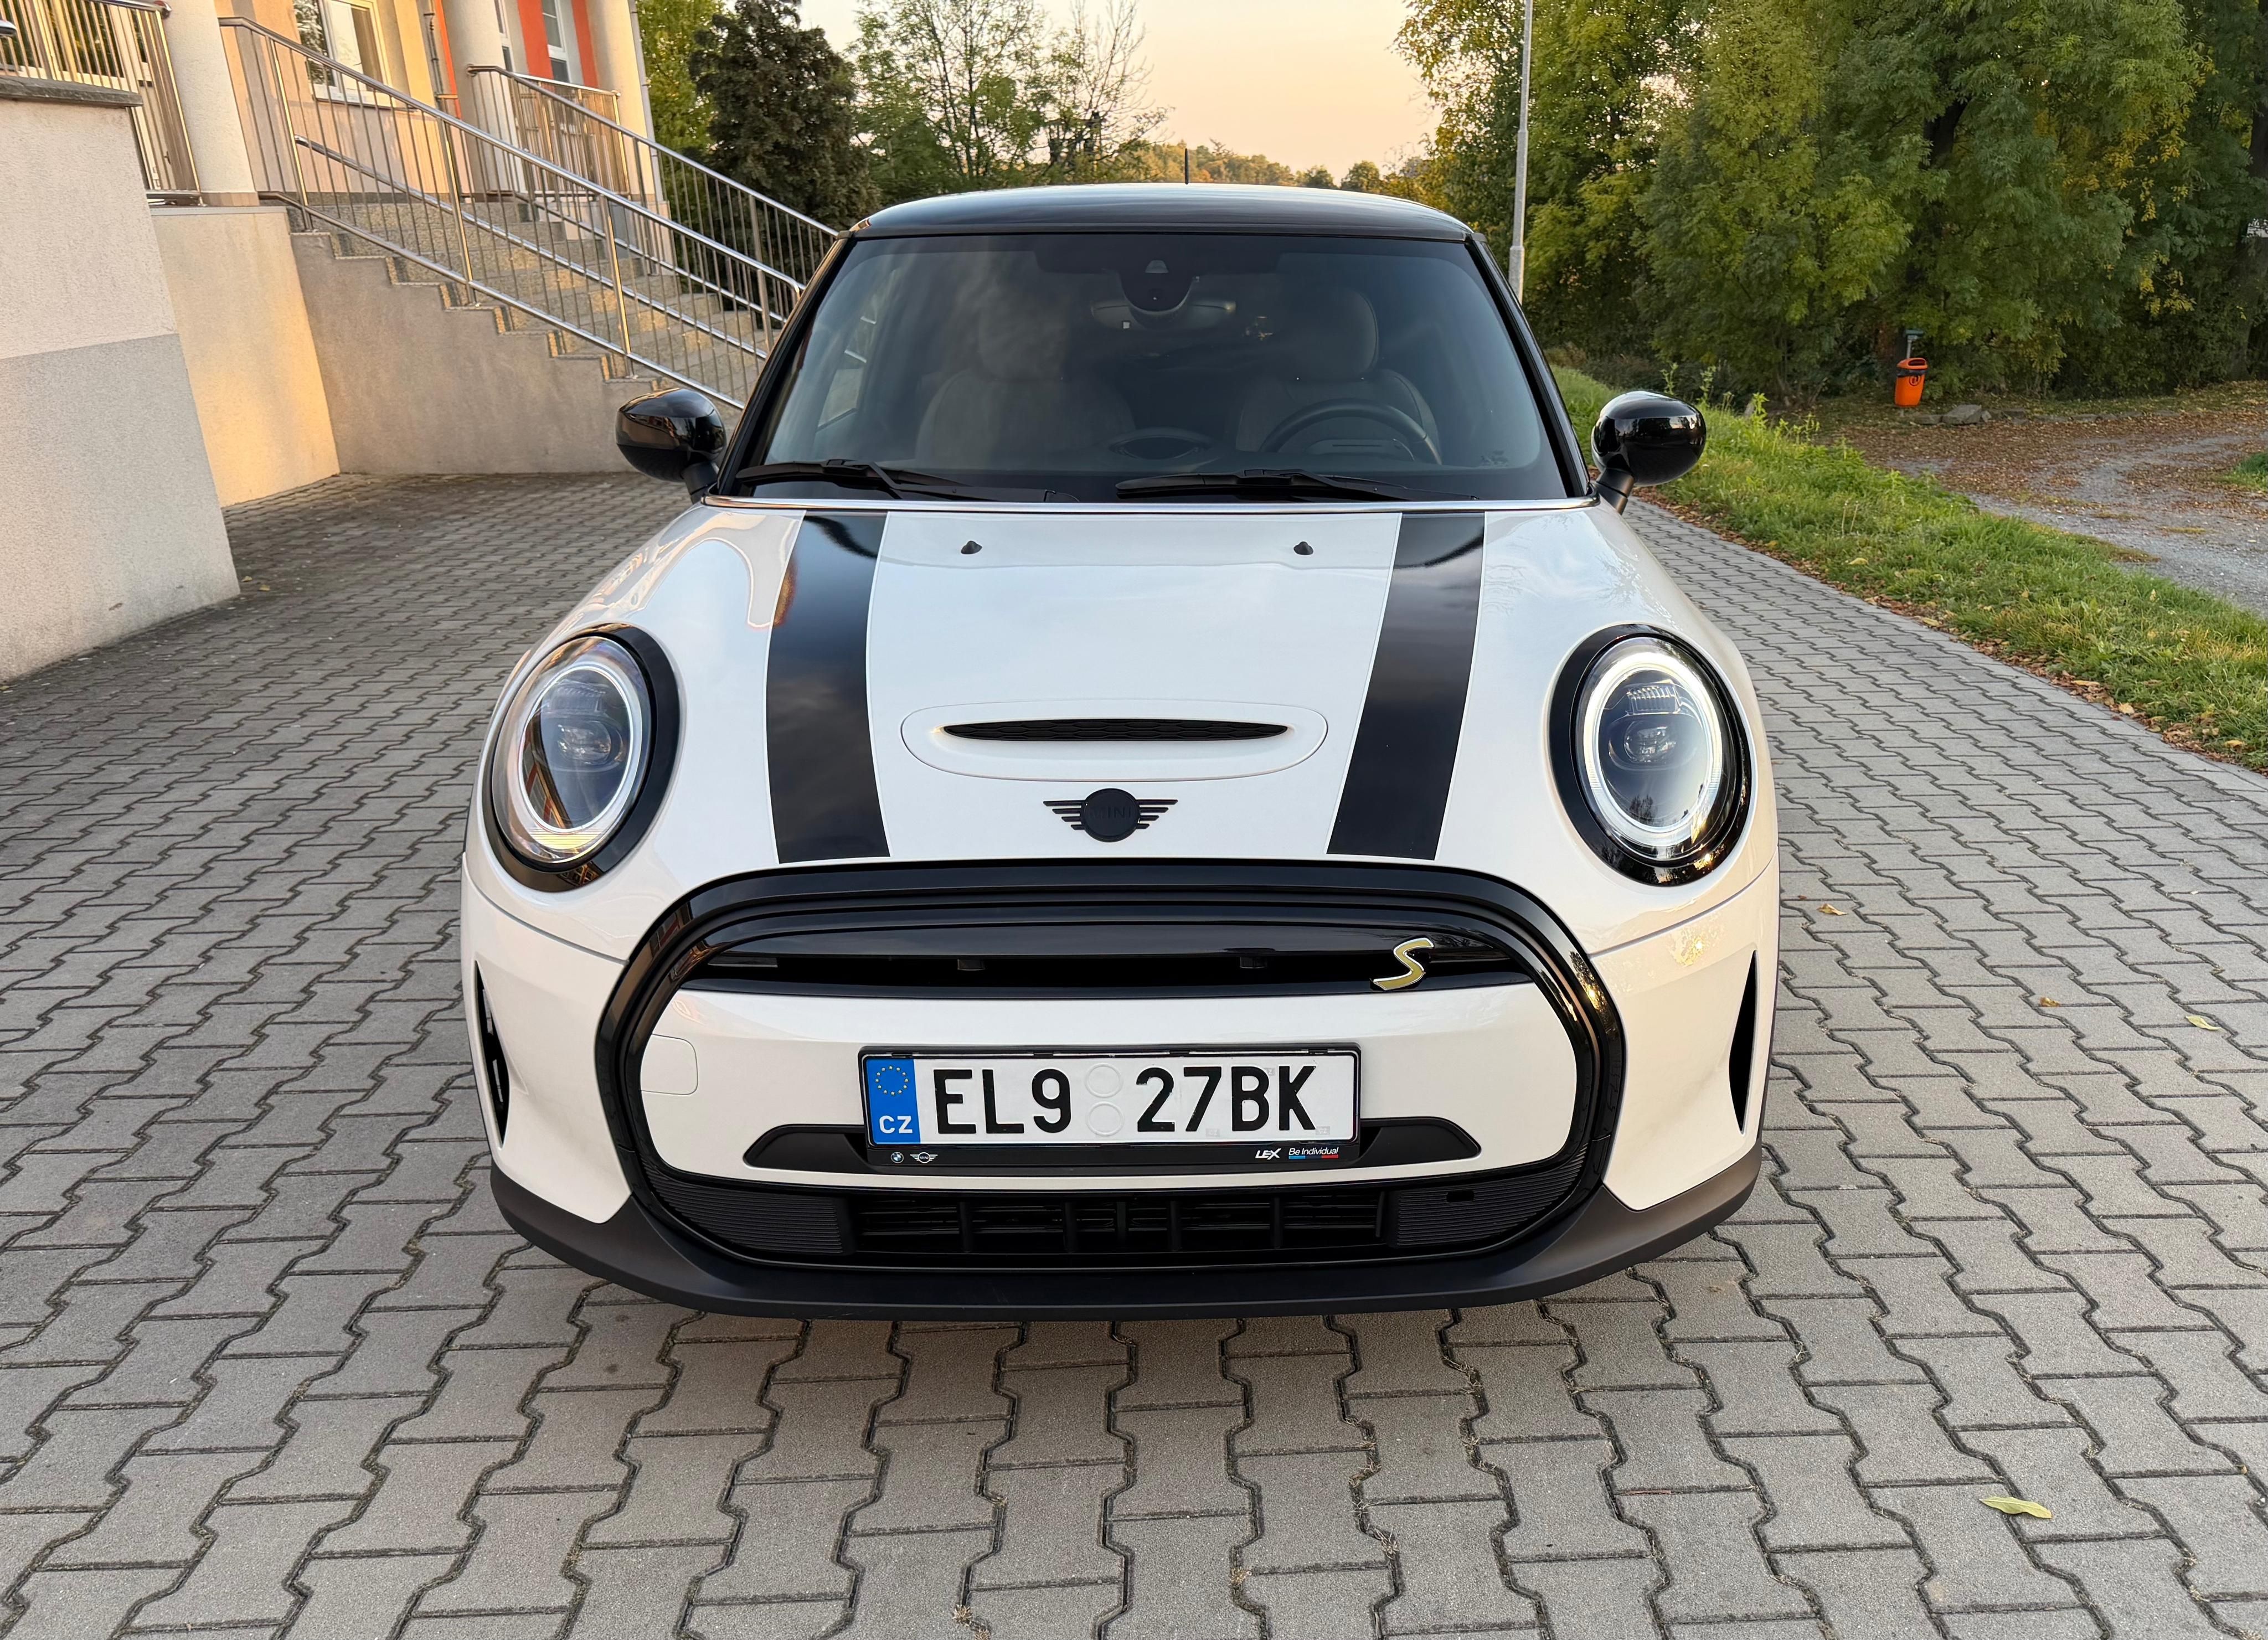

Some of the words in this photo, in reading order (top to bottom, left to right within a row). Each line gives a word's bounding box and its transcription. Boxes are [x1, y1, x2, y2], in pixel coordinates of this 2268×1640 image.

[1373, 937, 1434, 991] S
[933, 1069, 1071, 1134] EL9
[1136, 1065, 1316, 1132] 27BK
[879, 1115, 913, 1134] CZ
[1255, 1148, 1281, 1160] LEX
[1301, 1147, 1339, 1155] Individual
